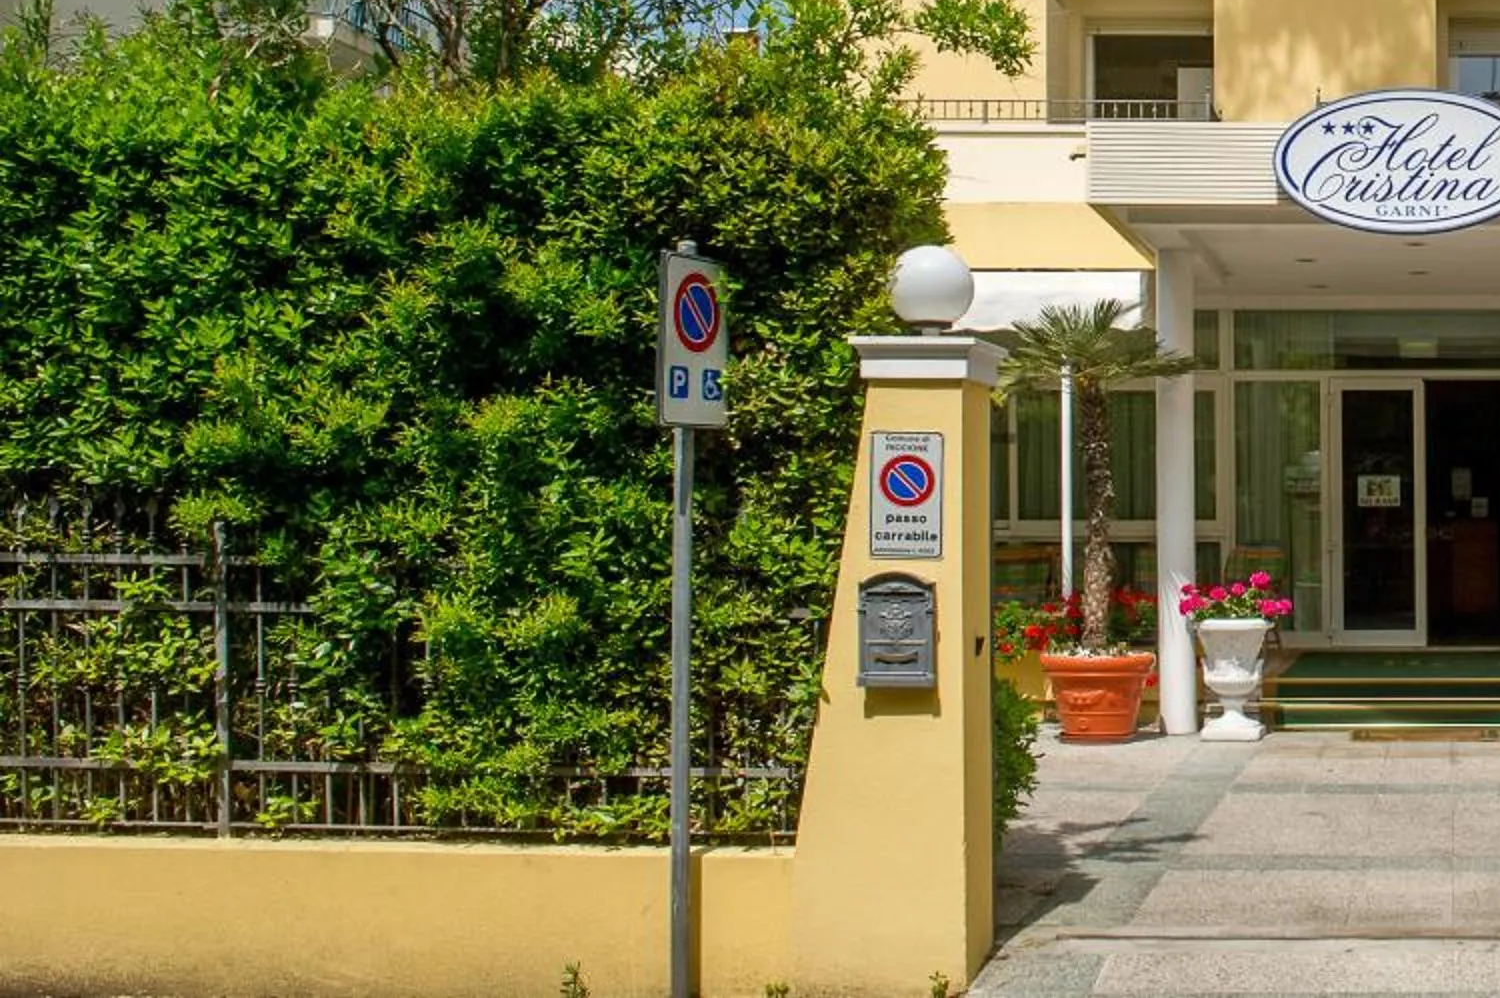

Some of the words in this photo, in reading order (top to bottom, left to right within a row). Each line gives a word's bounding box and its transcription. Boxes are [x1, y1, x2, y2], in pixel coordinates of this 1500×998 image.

[1302, 141, 1499, 203] Cristina
[673, 370, 686, 395] P
[886, 514, 927, 524] passo
[875, 531, 938, 541] carrabile
